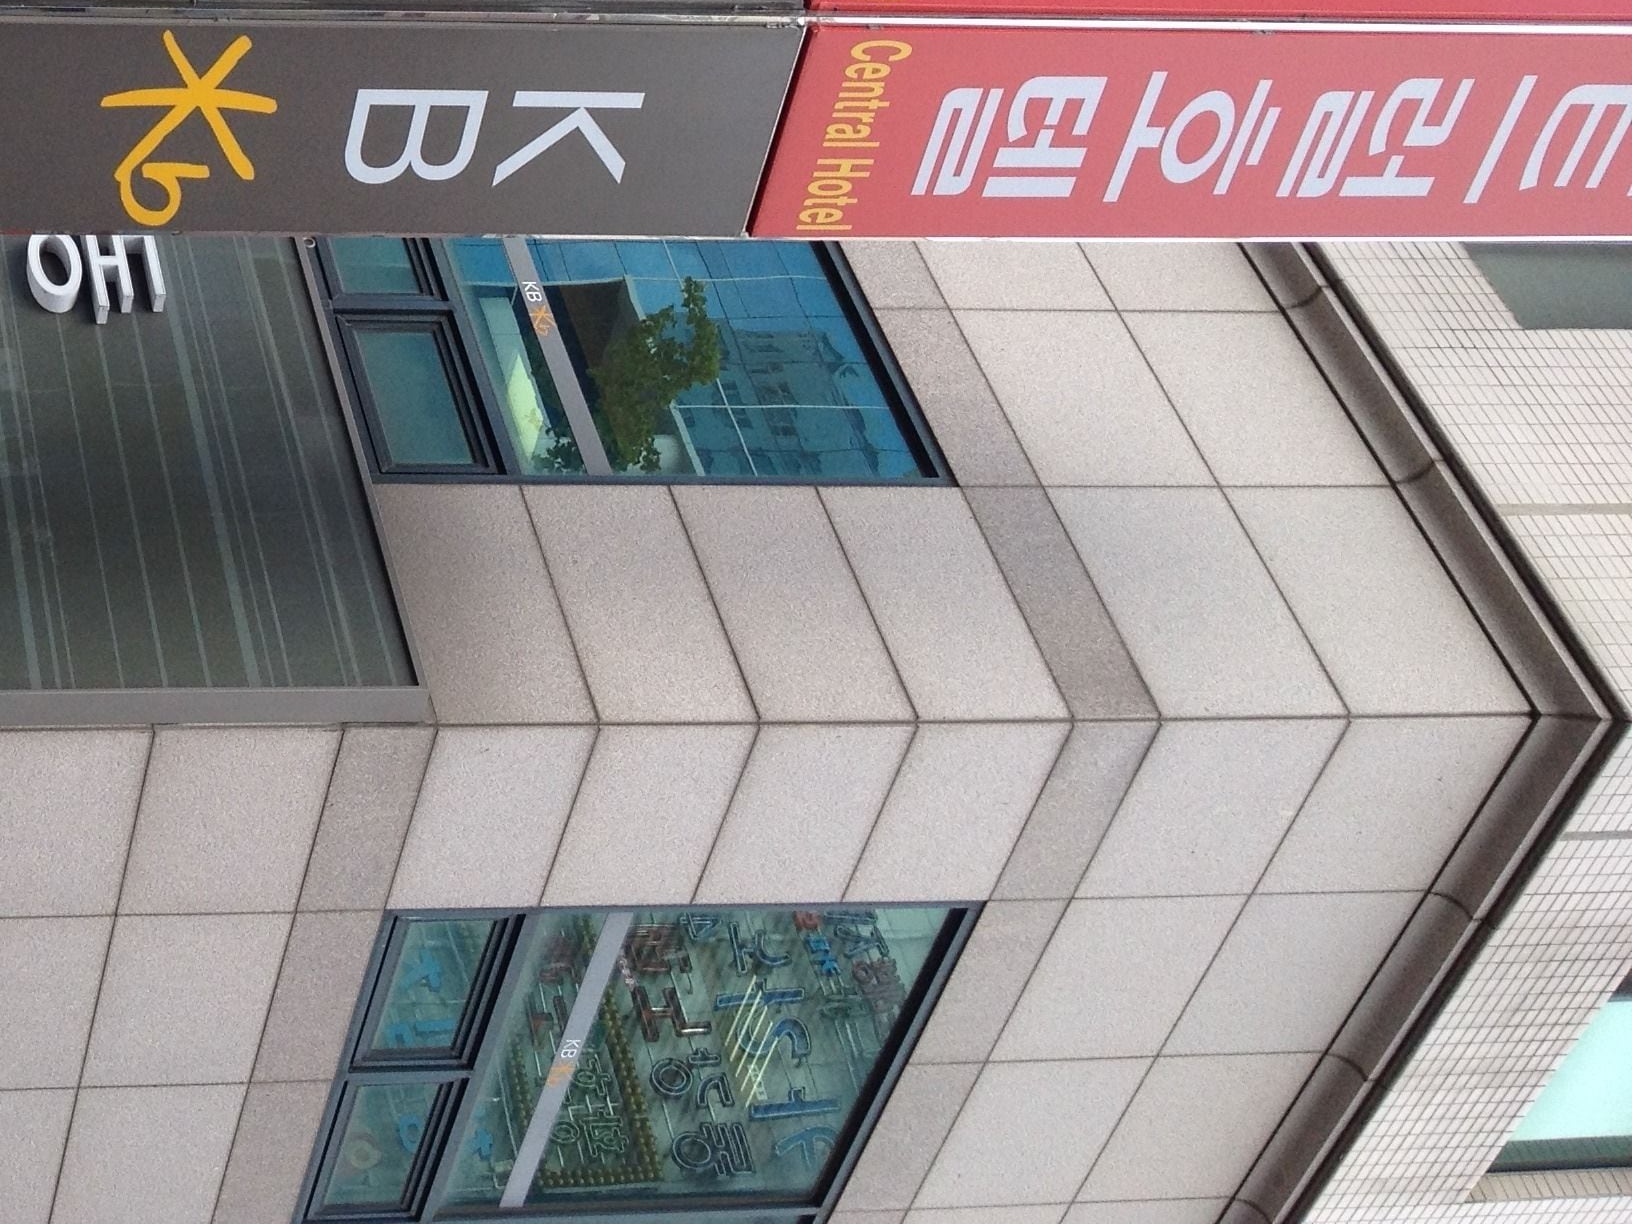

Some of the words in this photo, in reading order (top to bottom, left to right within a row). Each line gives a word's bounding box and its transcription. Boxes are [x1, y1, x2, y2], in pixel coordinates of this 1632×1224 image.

[821, 39, 913, 148] Central
[910, 71, 1632, 204] 트럴호텔
[795, 158, 874, 232] Hotel
[523, 281, 542, 303] KB
